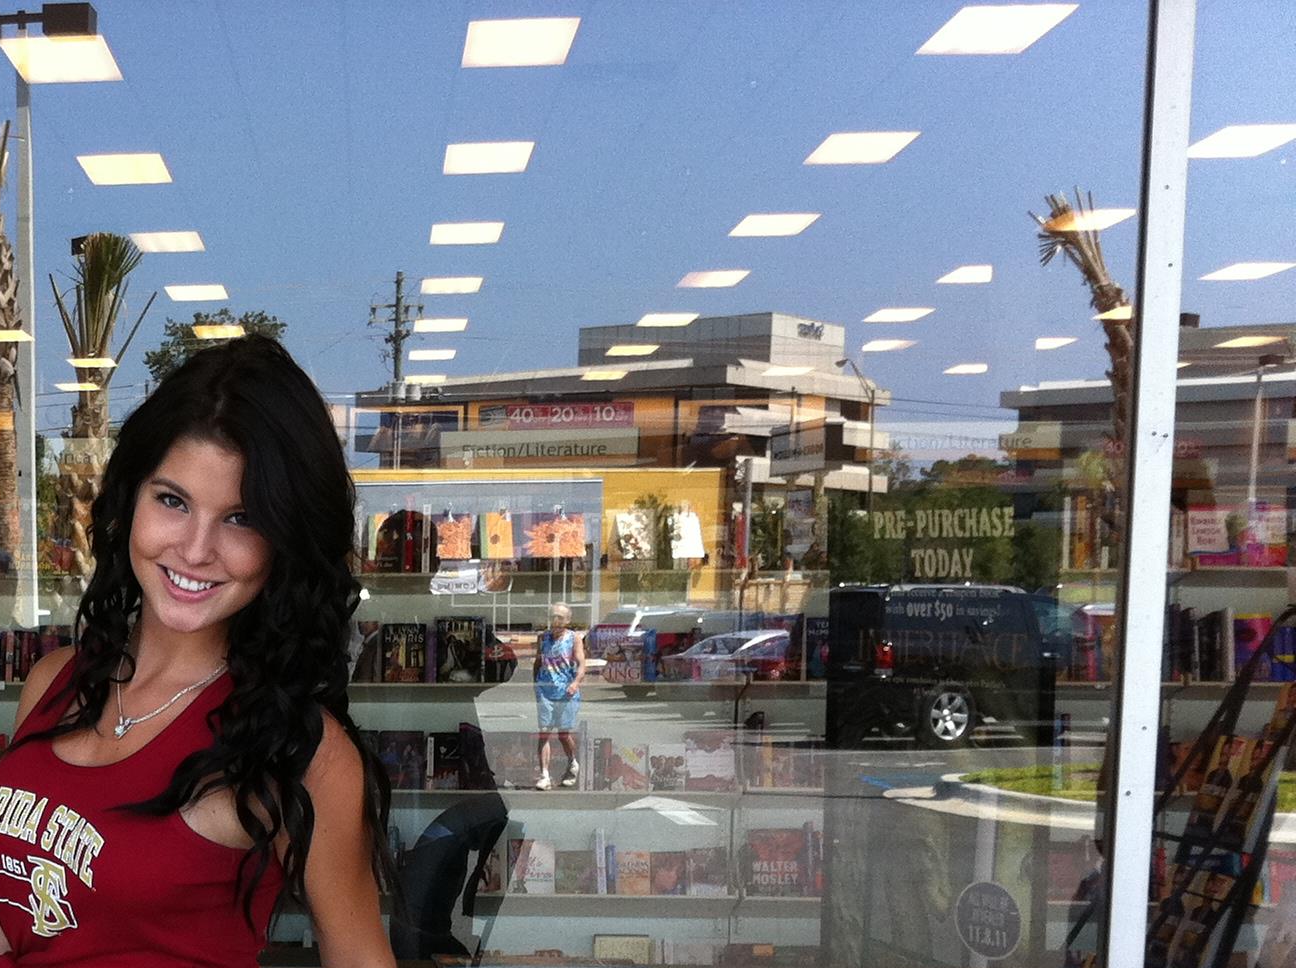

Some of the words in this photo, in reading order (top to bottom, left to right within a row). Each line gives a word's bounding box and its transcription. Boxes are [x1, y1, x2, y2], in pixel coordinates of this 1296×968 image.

[461, 442, 608, 458] Fiction/Literature
[872, 506, 1016, 540] PRE-PURCHASE
[910, 548, 975, 578] TODAY
[906, 602, 932, 617] over
[934, 600, 954, 621] $50
[40, 804, 105, 888] STATE
[1, 854, 28, 875] 1851
[752, 860, 797, 872] WALTER
[752, 873, 799, 885] MOSLEY
